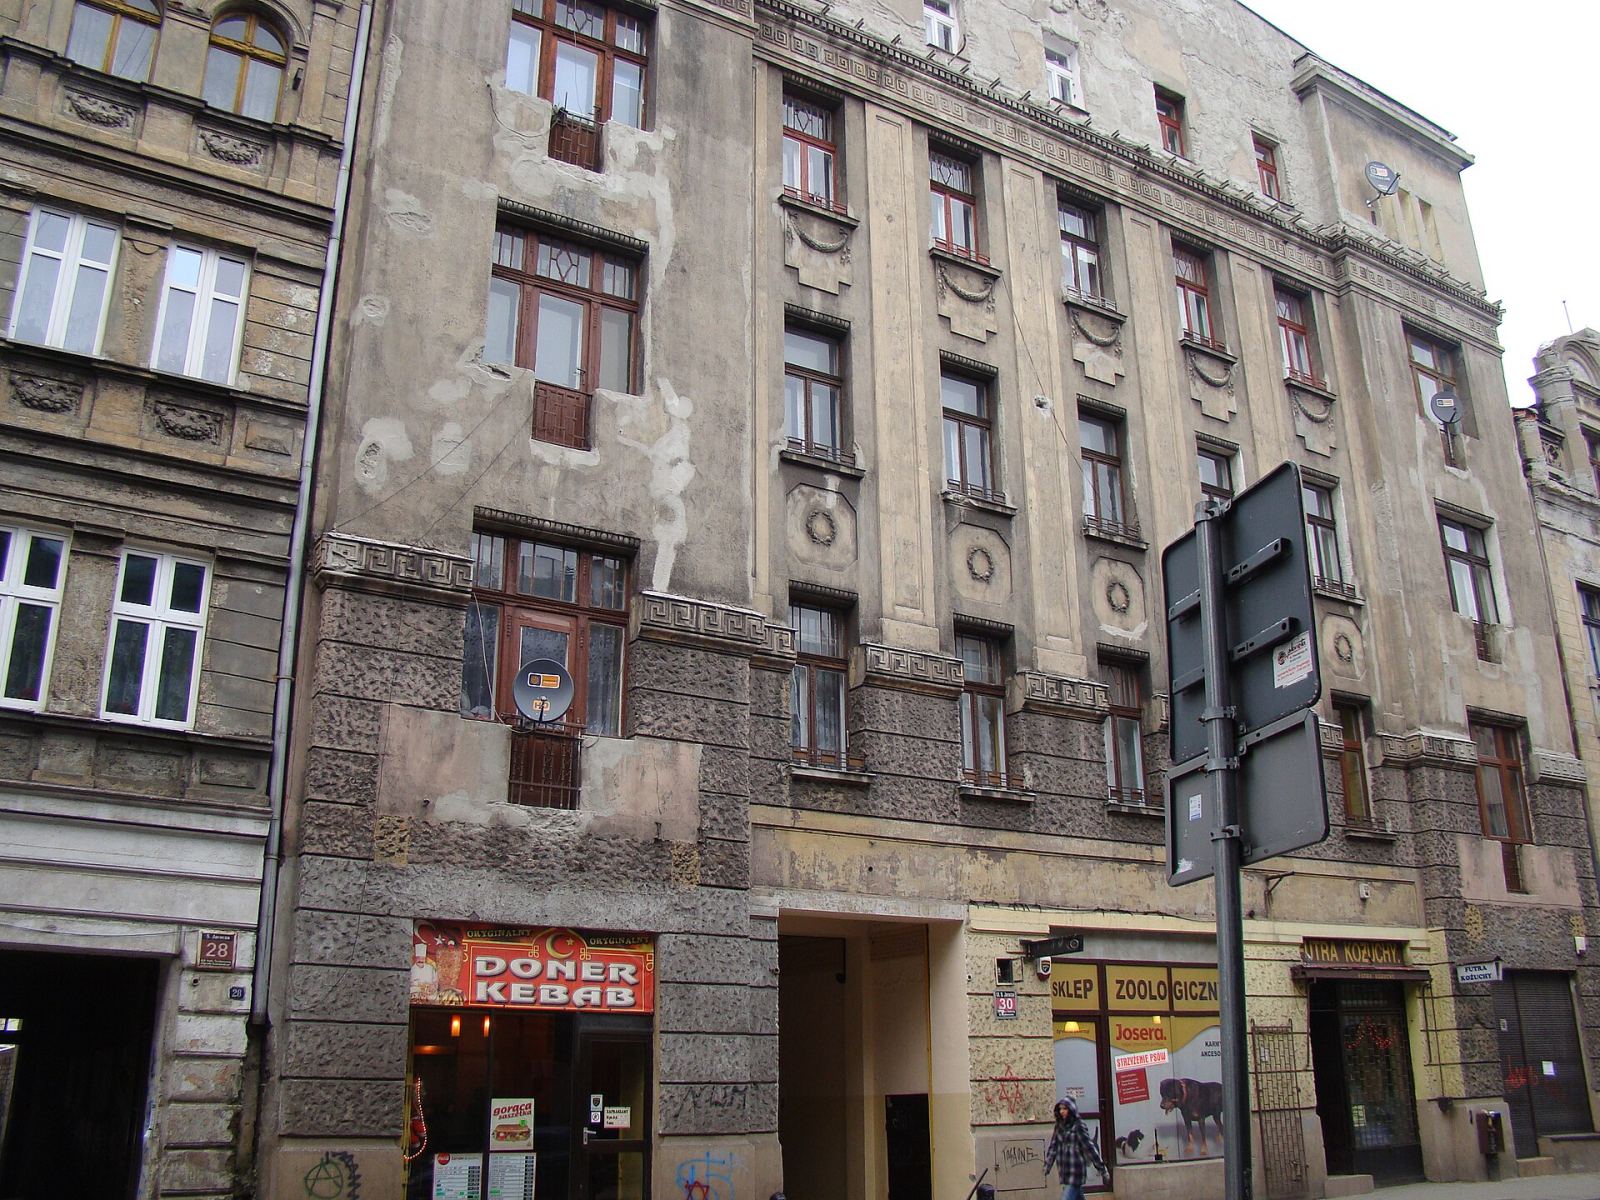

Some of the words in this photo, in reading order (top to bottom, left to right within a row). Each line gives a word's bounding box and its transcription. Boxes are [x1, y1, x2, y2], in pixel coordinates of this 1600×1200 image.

[466, 929, 532, 938] ORYGINALNY
[589, 936, 651, 946] ORYGINALNY
[206, 942, 229, 958] 28
[1301, 941, 1339, 962] UTRA
[475, 956, 640, 985] DONER
[1464, 965, 1488, 973] FUTRA
[475, 980, 636, 1008] KEBAB
[1052, 979, 1094, 999] SKLEP
[1115, 979, 1219, 1001] ZOOLOGICZN
[998, 998, 1013, 1010] 30
[1115, 1023, 1167, 1041] Josera.
[493, 1102, 532, 1117] gorąca
